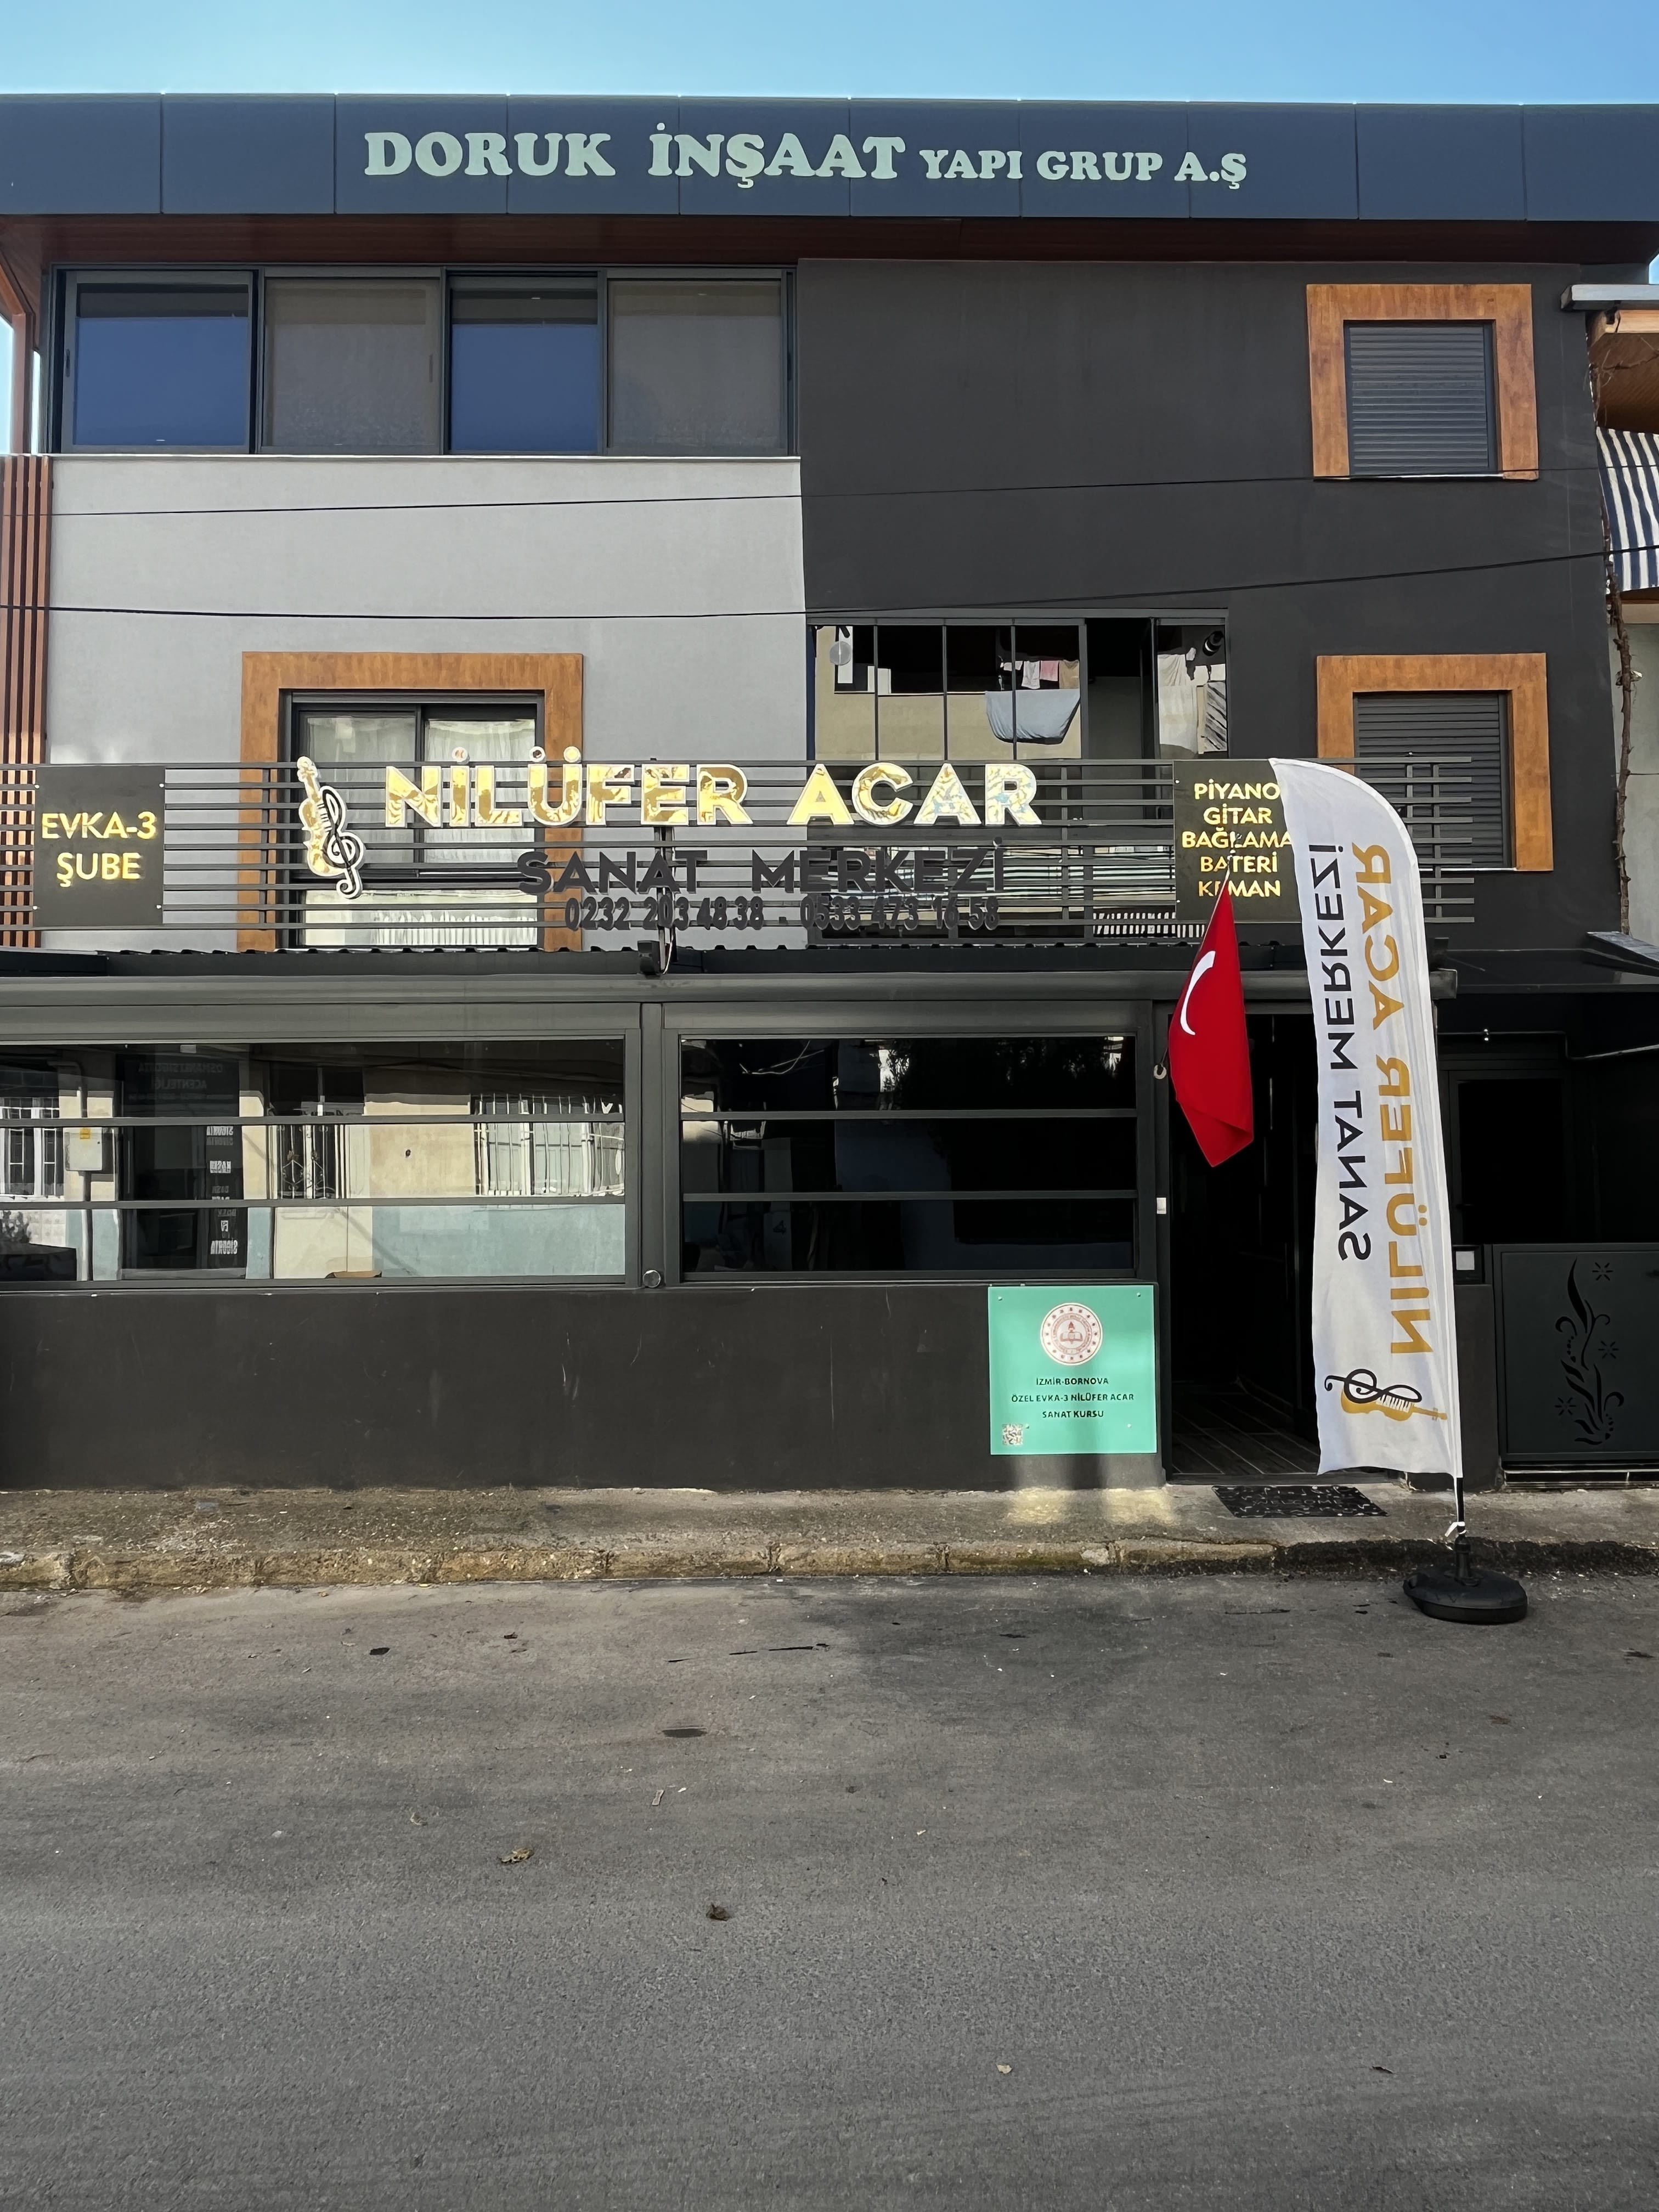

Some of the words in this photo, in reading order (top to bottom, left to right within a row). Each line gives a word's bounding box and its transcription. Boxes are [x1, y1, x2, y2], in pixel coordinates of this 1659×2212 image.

[364, 132, 616, 176] DORUK
[648, 122, 906, 188] İNŞAAT
[919, 150, 1024, 179] YAPI
[1036, 151, 1163, 181] GRUP
[1174, 152, 1247, 189] A.Ş
[385, 746, 753, 827] NİLÜFER
[787, 762, 1042, 825] ACAR
[1194, 778, 1281, 800] PİYANO
[41, 811, 157, 840] EVKA-3
[1203, 803, 1273, 825] GİTAR
[1182, 827, 1293, 848] BAĞLAMA
[57, 852, 142, 887] ŞUBE
[517, 850, 708, 894] SANAT
[752, 837, 1005, 893] MERKEZİ
[1200, 851, 1278, 873] BATERİ
[565, 896, 631, 932] 0232
[644, 896, 690, 931] 203
[730, 896, 764, 930] 38
[800, 896, 861, 930] 0533
[968, 896, 999, 930] 58
[1011, 1394, 1034, 1402] ÖZEL
[1071, 1392, 1108, 1401] NİLÜFER
